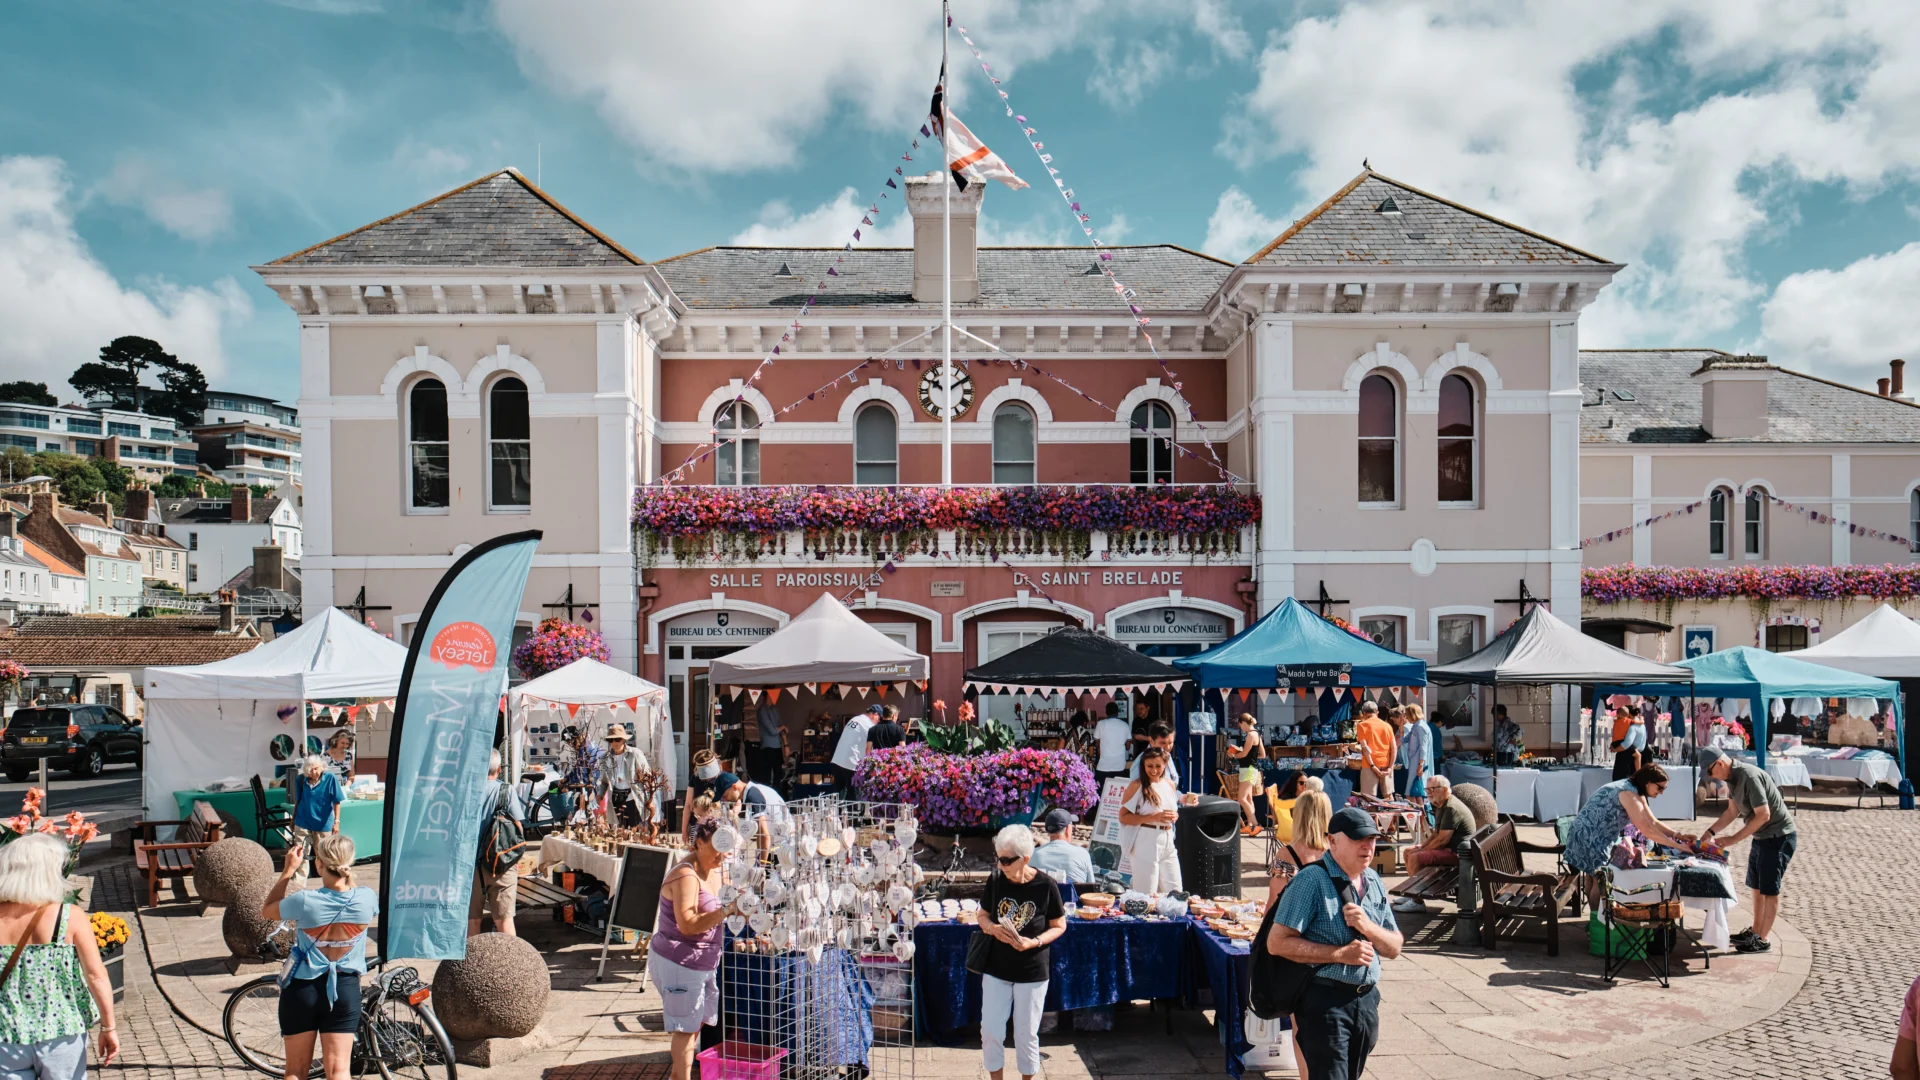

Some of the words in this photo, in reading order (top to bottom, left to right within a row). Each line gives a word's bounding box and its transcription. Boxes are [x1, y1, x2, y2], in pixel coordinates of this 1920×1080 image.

[709, 573, 763, 587] SALLE
[776, 573, 882, 587] PAROISSIALE
[1040, 571, 1092, 586] SAINT
[1102, 571, 1184, 586] BRELADE
[670, 627, 705, 636] BUREAU
[706, 627, 723, 636] DES
[726, 627, 776, 636] CENTENIERS
[1116, 624, 1151, 634] BUREAU
[1153, 624, 1166, 634] DU
[1168, 622, 1223, 634] CONNÉTABLE
[1287, 669, 1306, 678] Made
[1306, 669, 1315, 679] by
[1316, 669, 1328, 677] the
[1329, 668, 1341, 678] Bay
